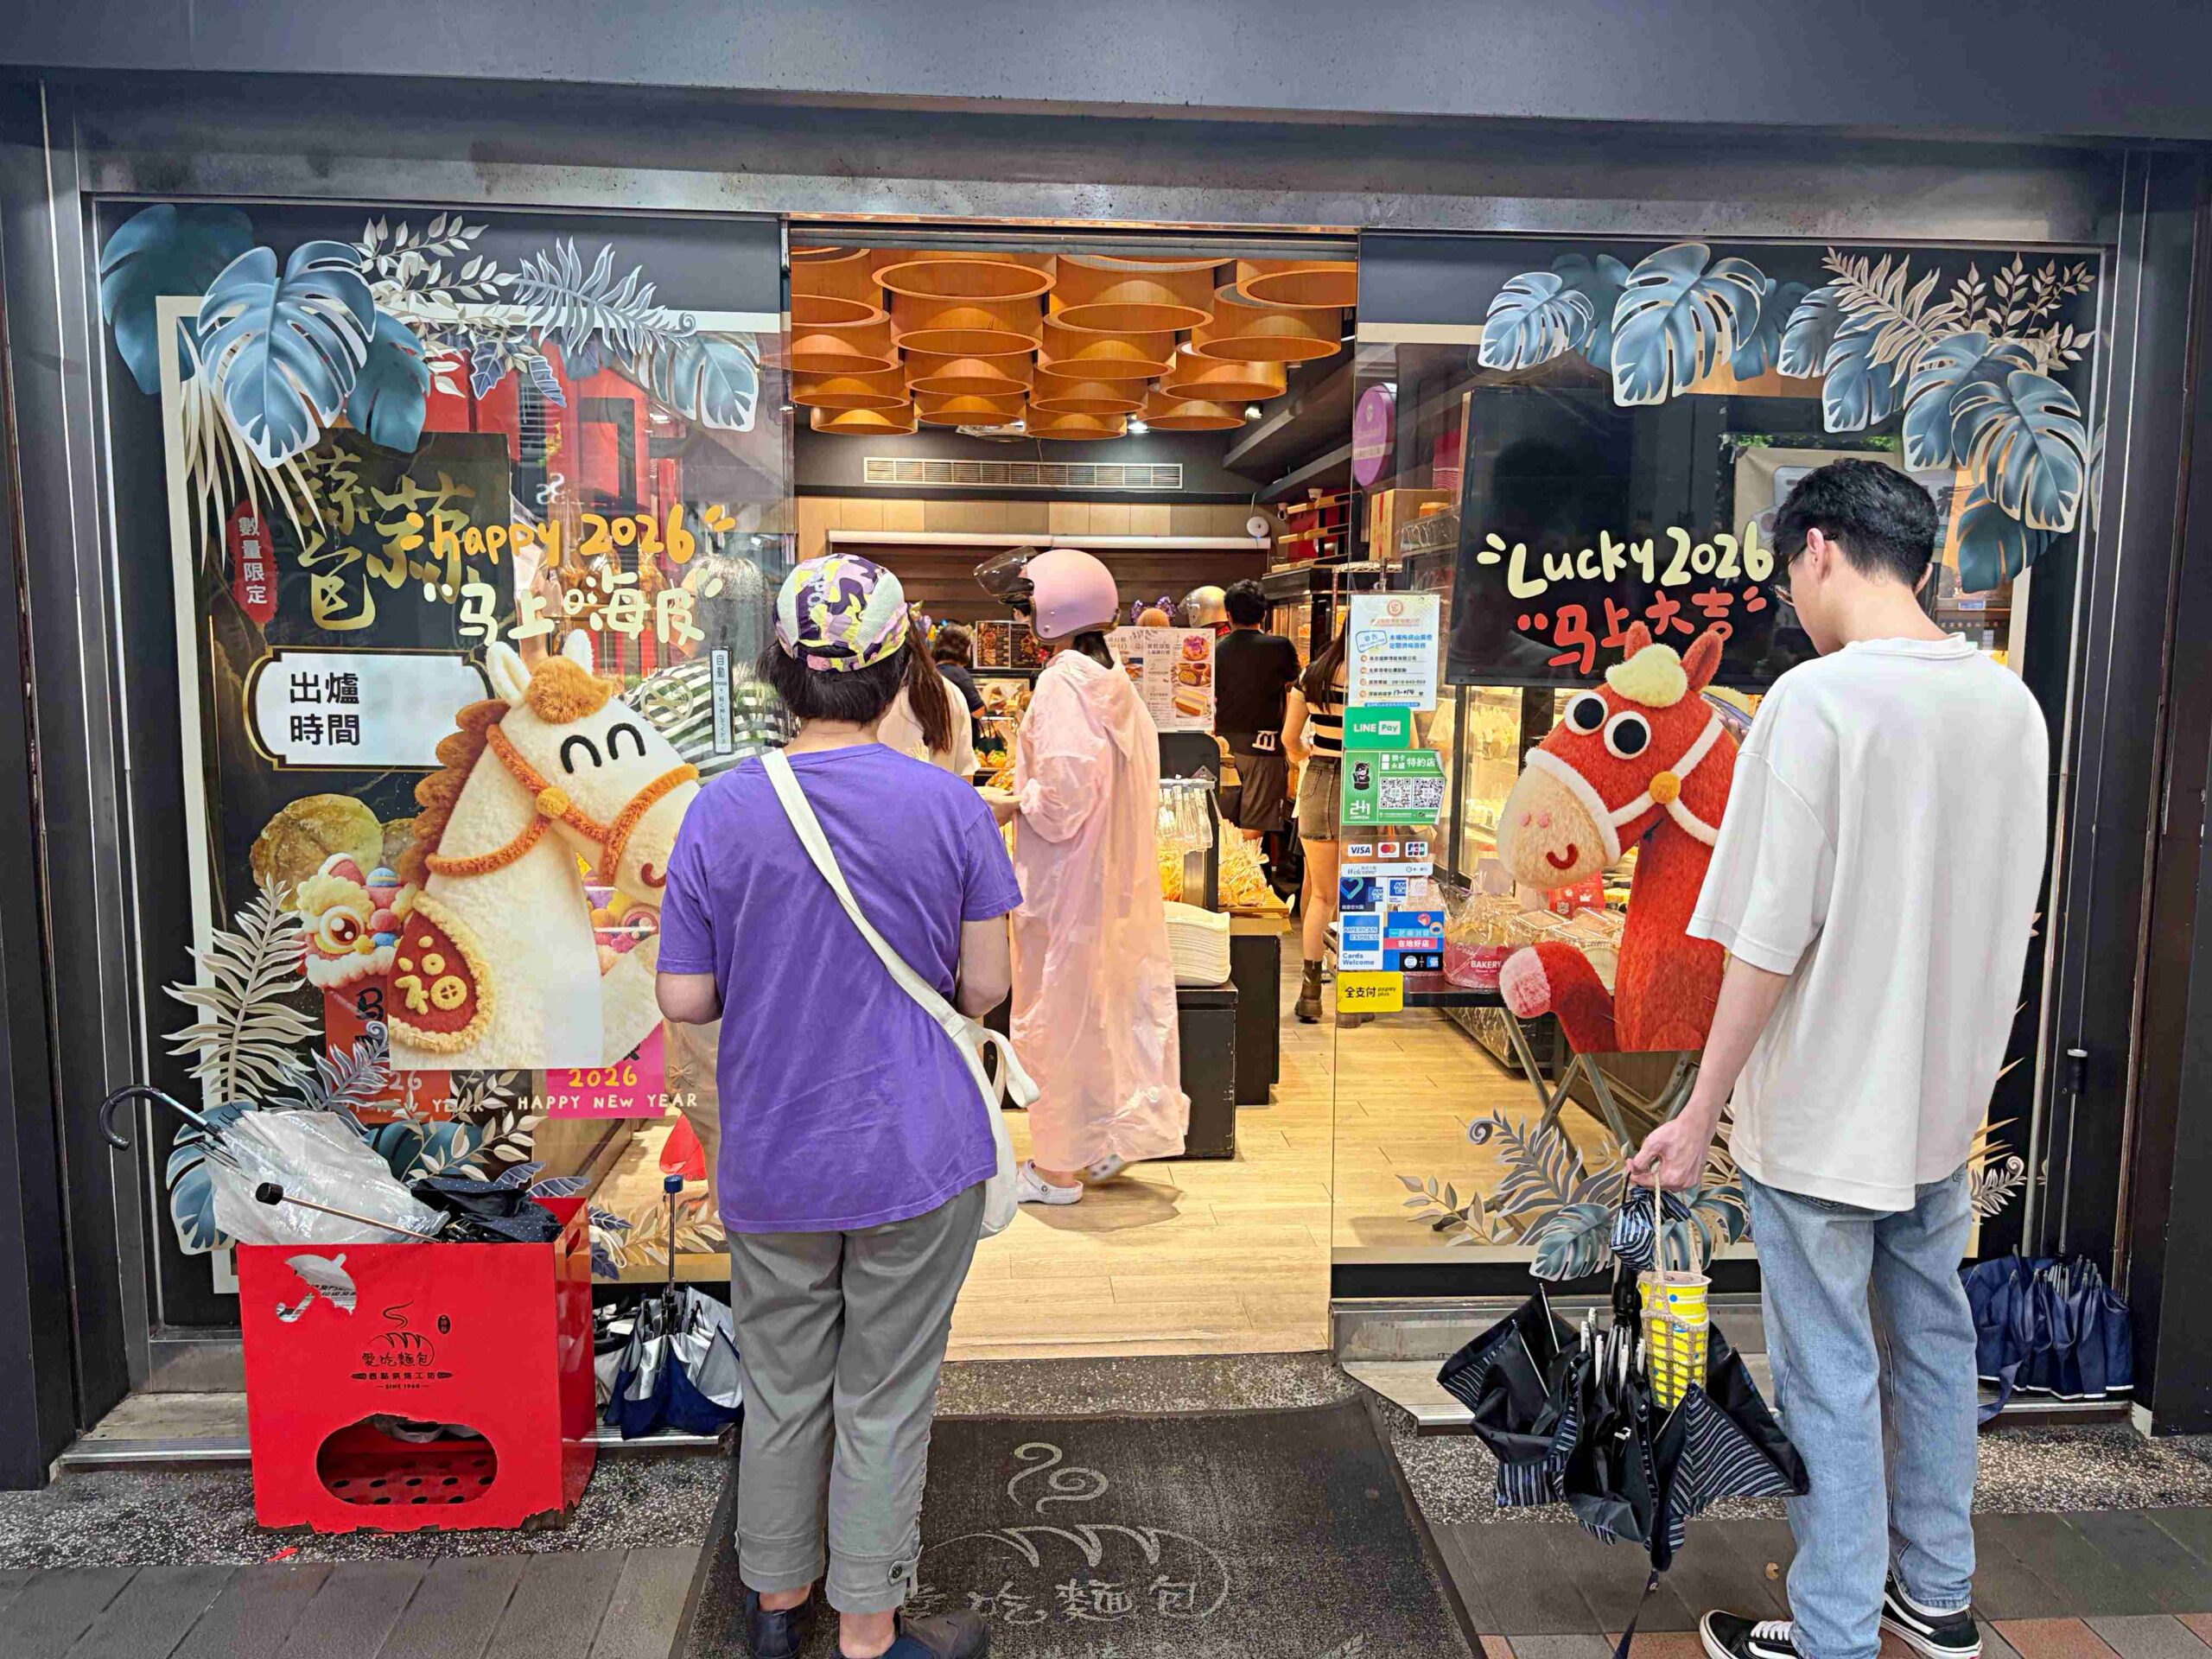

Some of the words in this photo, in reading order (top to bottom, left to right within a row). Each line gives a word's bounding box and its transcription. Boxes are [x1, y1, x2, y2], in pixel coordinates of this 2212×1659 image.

[434, 515, 560, 568] happy
[580, 504, 696, 563] 2026
[238, 517, 268, 604] 數量限定
[1508, 530, 1654, 599] Lucky
[1661, 521, 1774, 587] 2026
[1548, 588, 1734, 674] 马上大吉
[289, 672, 360, 705] 出爐
[289, 714, 361, 747] 時間
[1353, 723, 1376, 733] LINE
[1382, 724, 1398, 734] Pay
[1408, 843, 1425, 856] JCB
[1347, 867, 1377, 875] Welcome
[1398, 939, 1430, 948] 在地好店
[1471, 960, 1502, 969] BAKERY
[1344, 987, 1376, 998] 全支付
[569, 1068, 638, 1088] 2026
[518, 1096, 581, 1110] HAPPY
[647, 1093, 698, 1109] YEAR
[362, 1352, 432, 1367] 愛吃麵包
